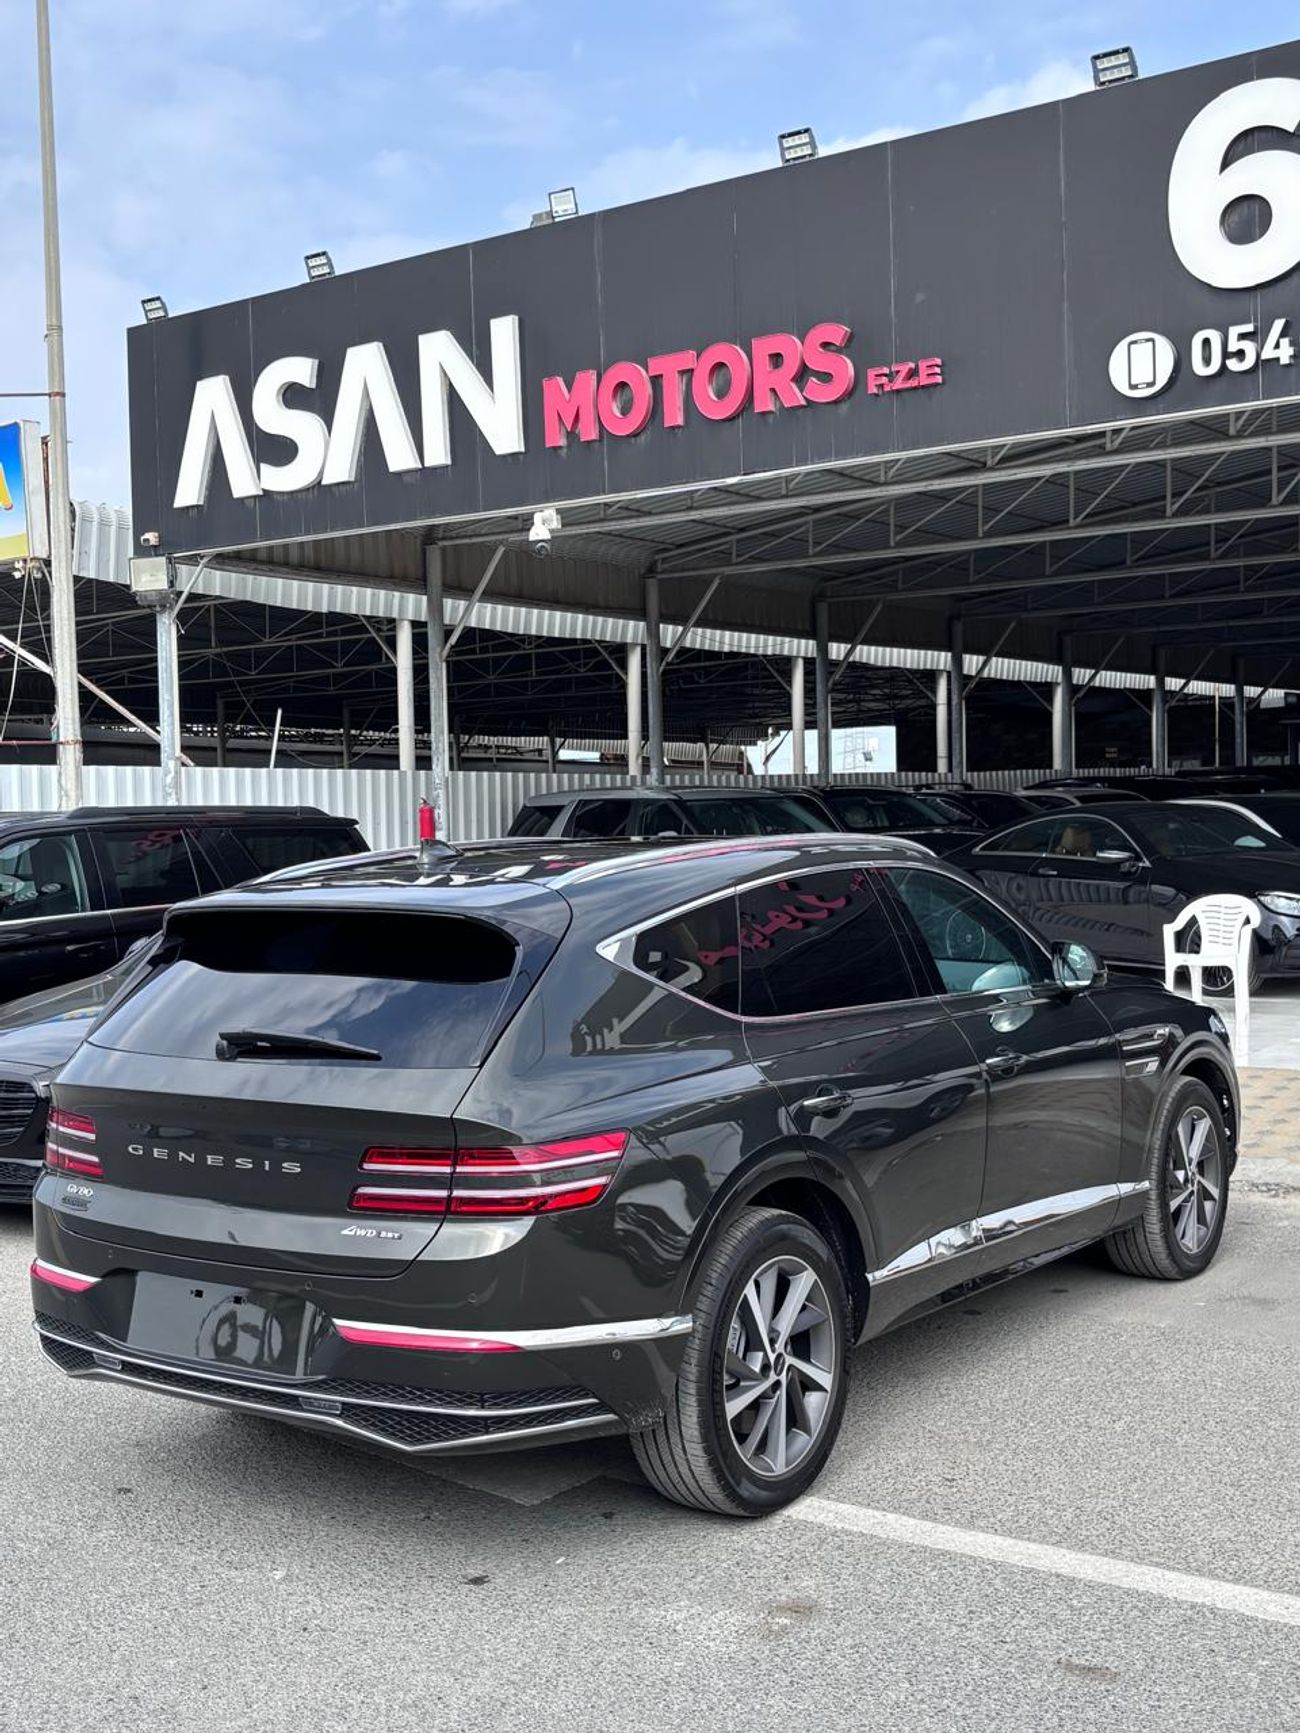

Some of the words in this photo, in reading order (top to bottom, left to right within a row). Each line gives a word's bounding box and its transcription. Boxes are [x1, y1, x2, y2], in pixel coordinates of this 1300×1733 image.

[1191, 318, 1296, 378] 054
[173, 314, 526, 509] ASAN
[542, 322, 854, 448] MOTORS
[128, 1143, 302, 1174] GENESIS
[340, 1225, 377, 1238] 4WD
